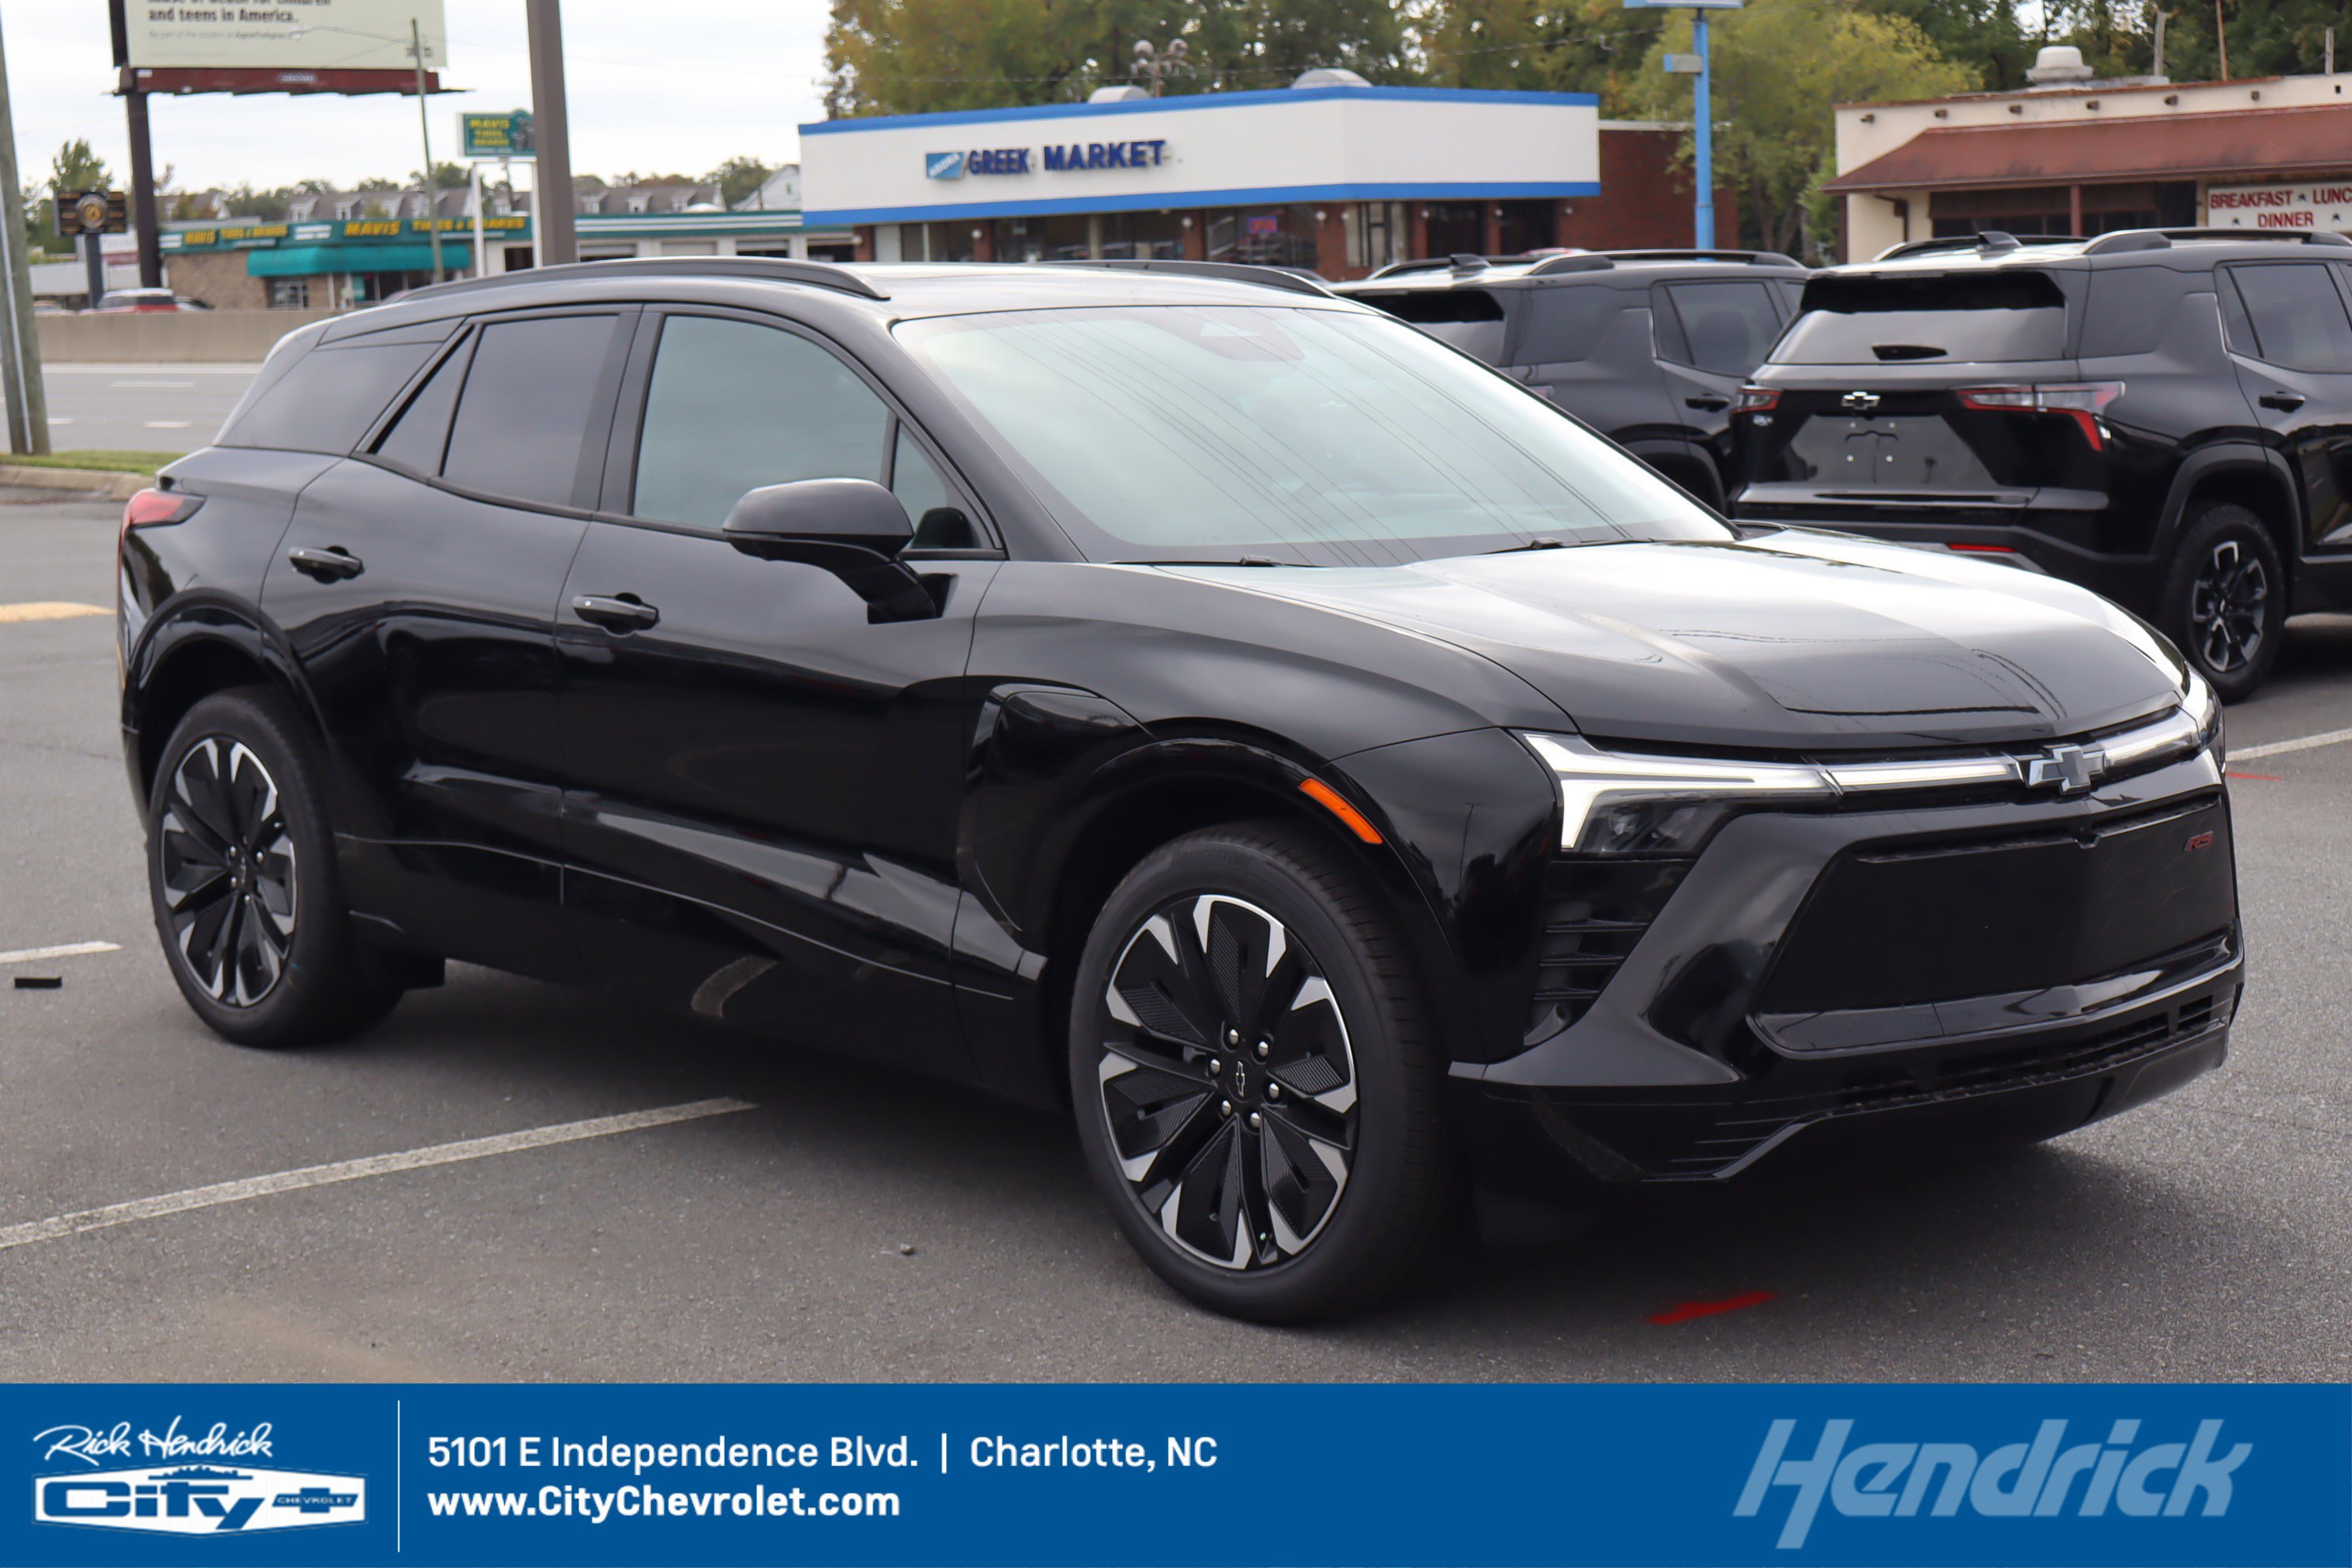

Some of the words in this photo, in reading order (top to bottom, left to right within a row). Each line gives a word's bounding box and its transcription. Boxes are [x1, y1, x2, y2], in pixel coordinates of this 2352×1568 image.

[149, 9, 175, 21] and
[179, 9, 217, 21] teens
[222, 8, 235, 21] in
[968, 149, 1031, 175] GREEK
[1044, 140, 1167, 172] MARKET
[2210, 189, 2294, 209] BREAKFAST
[2257, 211, 2315, 228] DINNER
[344, 220, 401, 236] MAVIS
[185, 229, 217, 245] MAVIS
